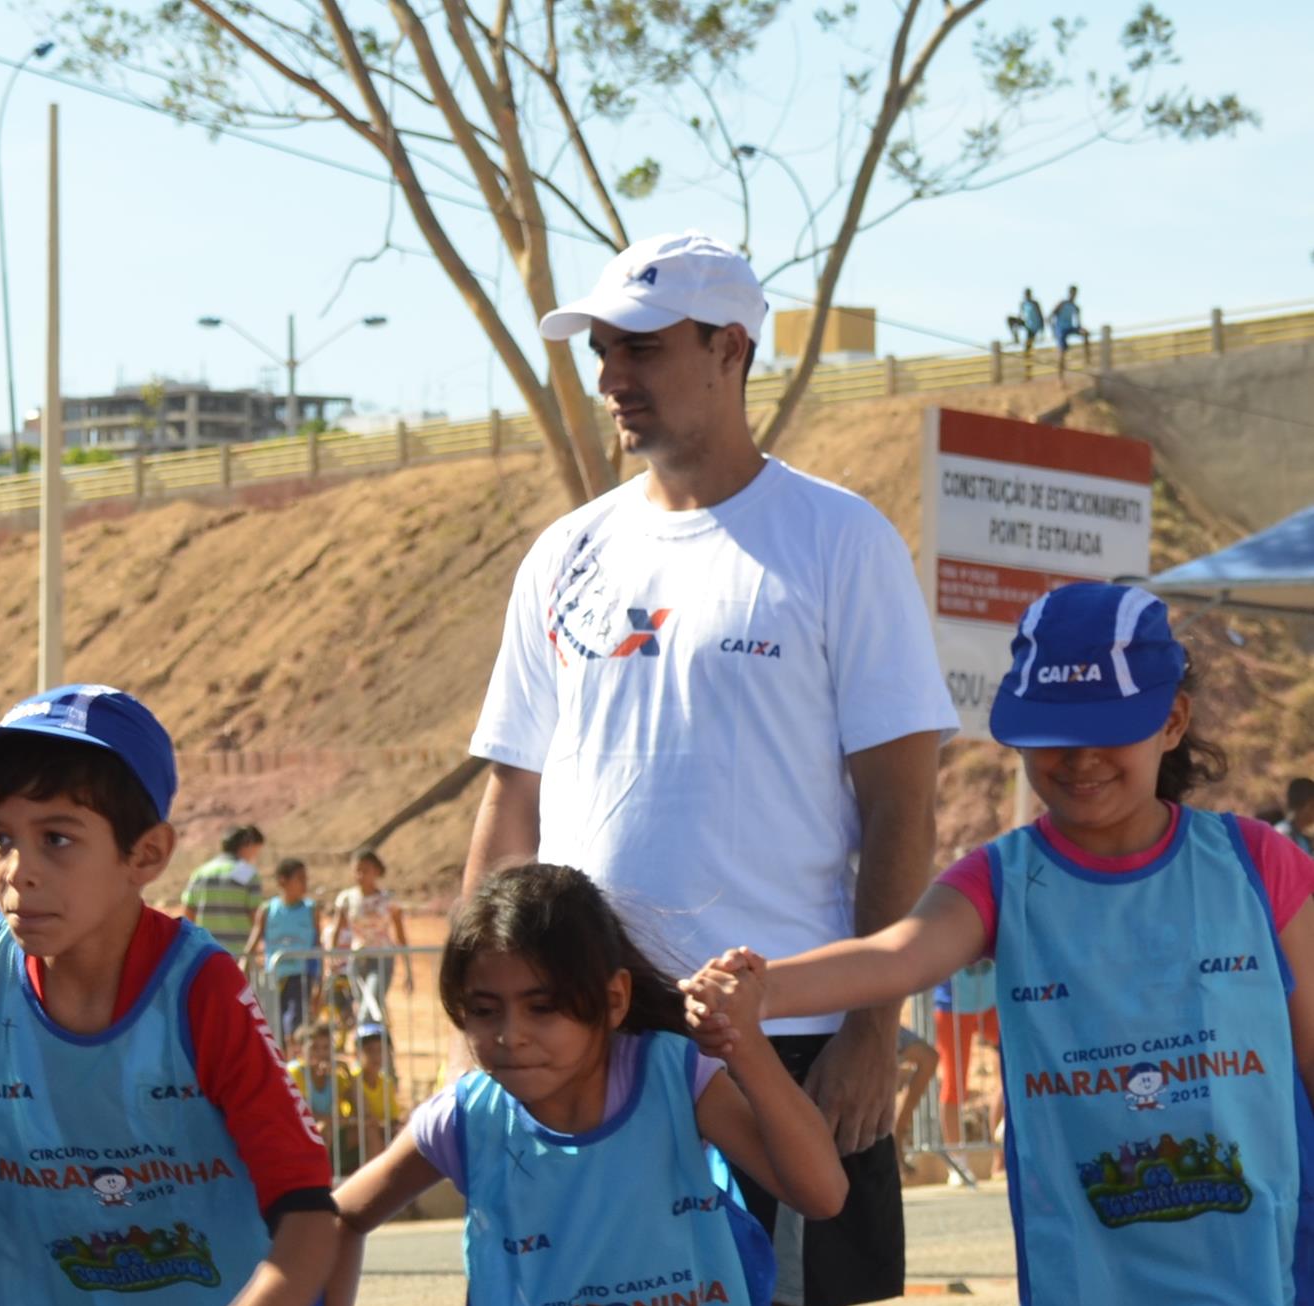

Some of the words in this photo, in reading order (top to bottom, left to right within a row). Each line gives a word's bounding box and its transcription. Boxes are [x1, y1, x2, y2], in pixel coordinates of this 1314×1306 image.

[942, 470, 1025, 509] CONSTRUÇÃO
[1030, 481, 1042, 510] DE
[1047, 485, 1142, 524] ESTACIONAMENTO
[989, 517, 1032, 549] PONTE
[720, 637, 781, 659] CAIXA
[1037, 663, 1102, 684] CAIXA
[1199, 955, 1259, 974] CAIXA
[1011, 982, 1070, 1002] CAIXA
[1063, 1043, 1137, 1064] CIRCUITO
[1142, 1033, 1195, 1052] CAIXA
[1198, 1029, 1217, 1043] DE
[1025, 1049, 1265, 1099] MARATNINHA
[150, 1082, 204, 1101] CAX
[1170, 1086, 1211, 1104] 2012
[29, 1145, 100, 1162] CIRCUITO
[104, 1143, 155, 1159] CAIXA
[136, 1184, 177, 1202] 2012
[503, 1233, 552, 1256] CXA
[615, 1275, 668, 1294] CAIXA
[671, 1269, 693, 1284] DE
